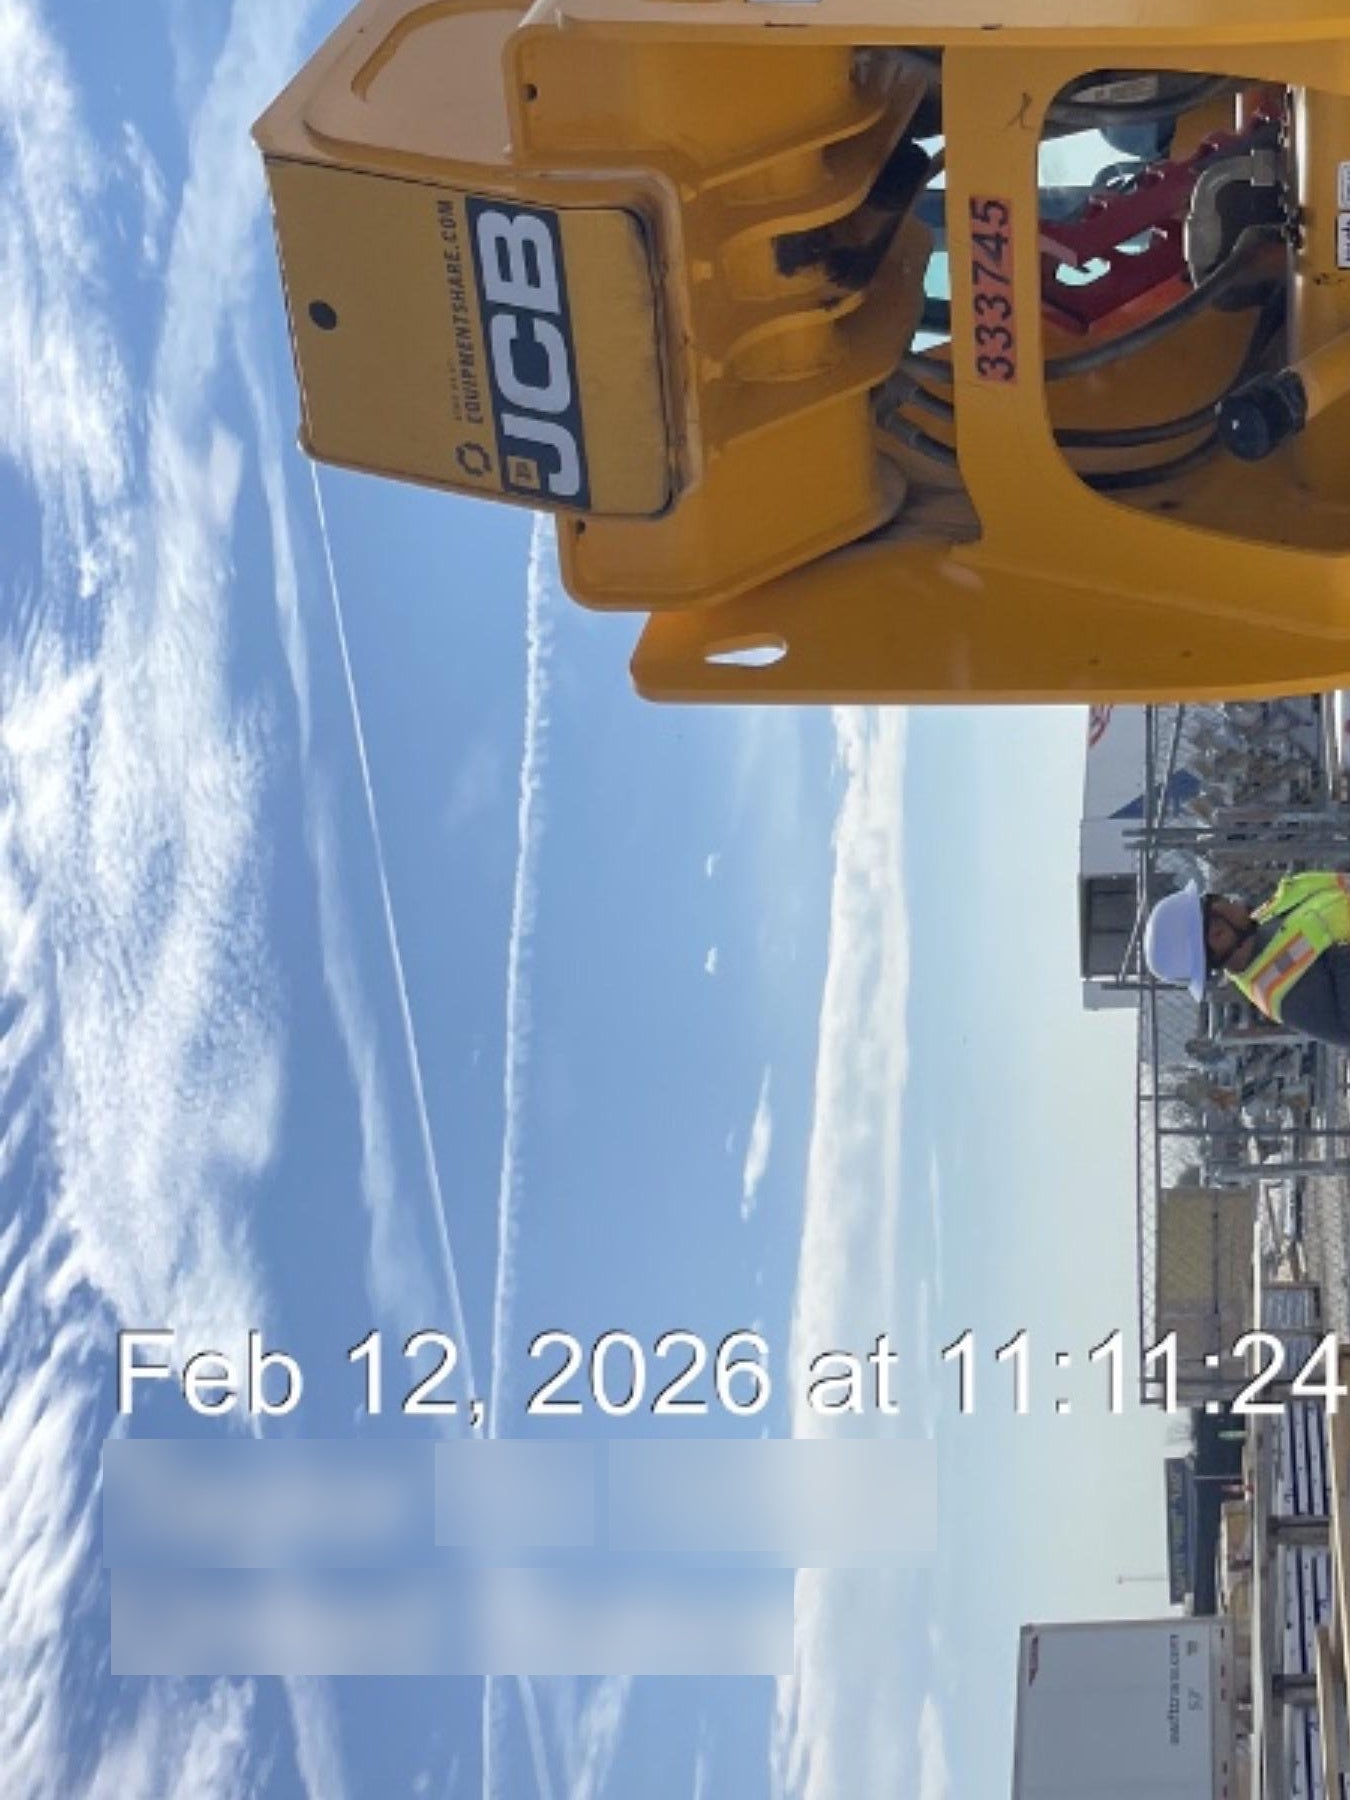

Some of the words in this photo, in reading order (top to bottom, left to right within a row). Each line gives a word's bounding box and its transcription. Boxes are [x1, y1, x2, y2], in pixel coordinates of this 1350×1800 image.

[436, 199, 484, 425] EQUIPMENTSHARE.COM
[475, 209, 580, 497] JCB
[968, 196, 1015, 382] 333745
